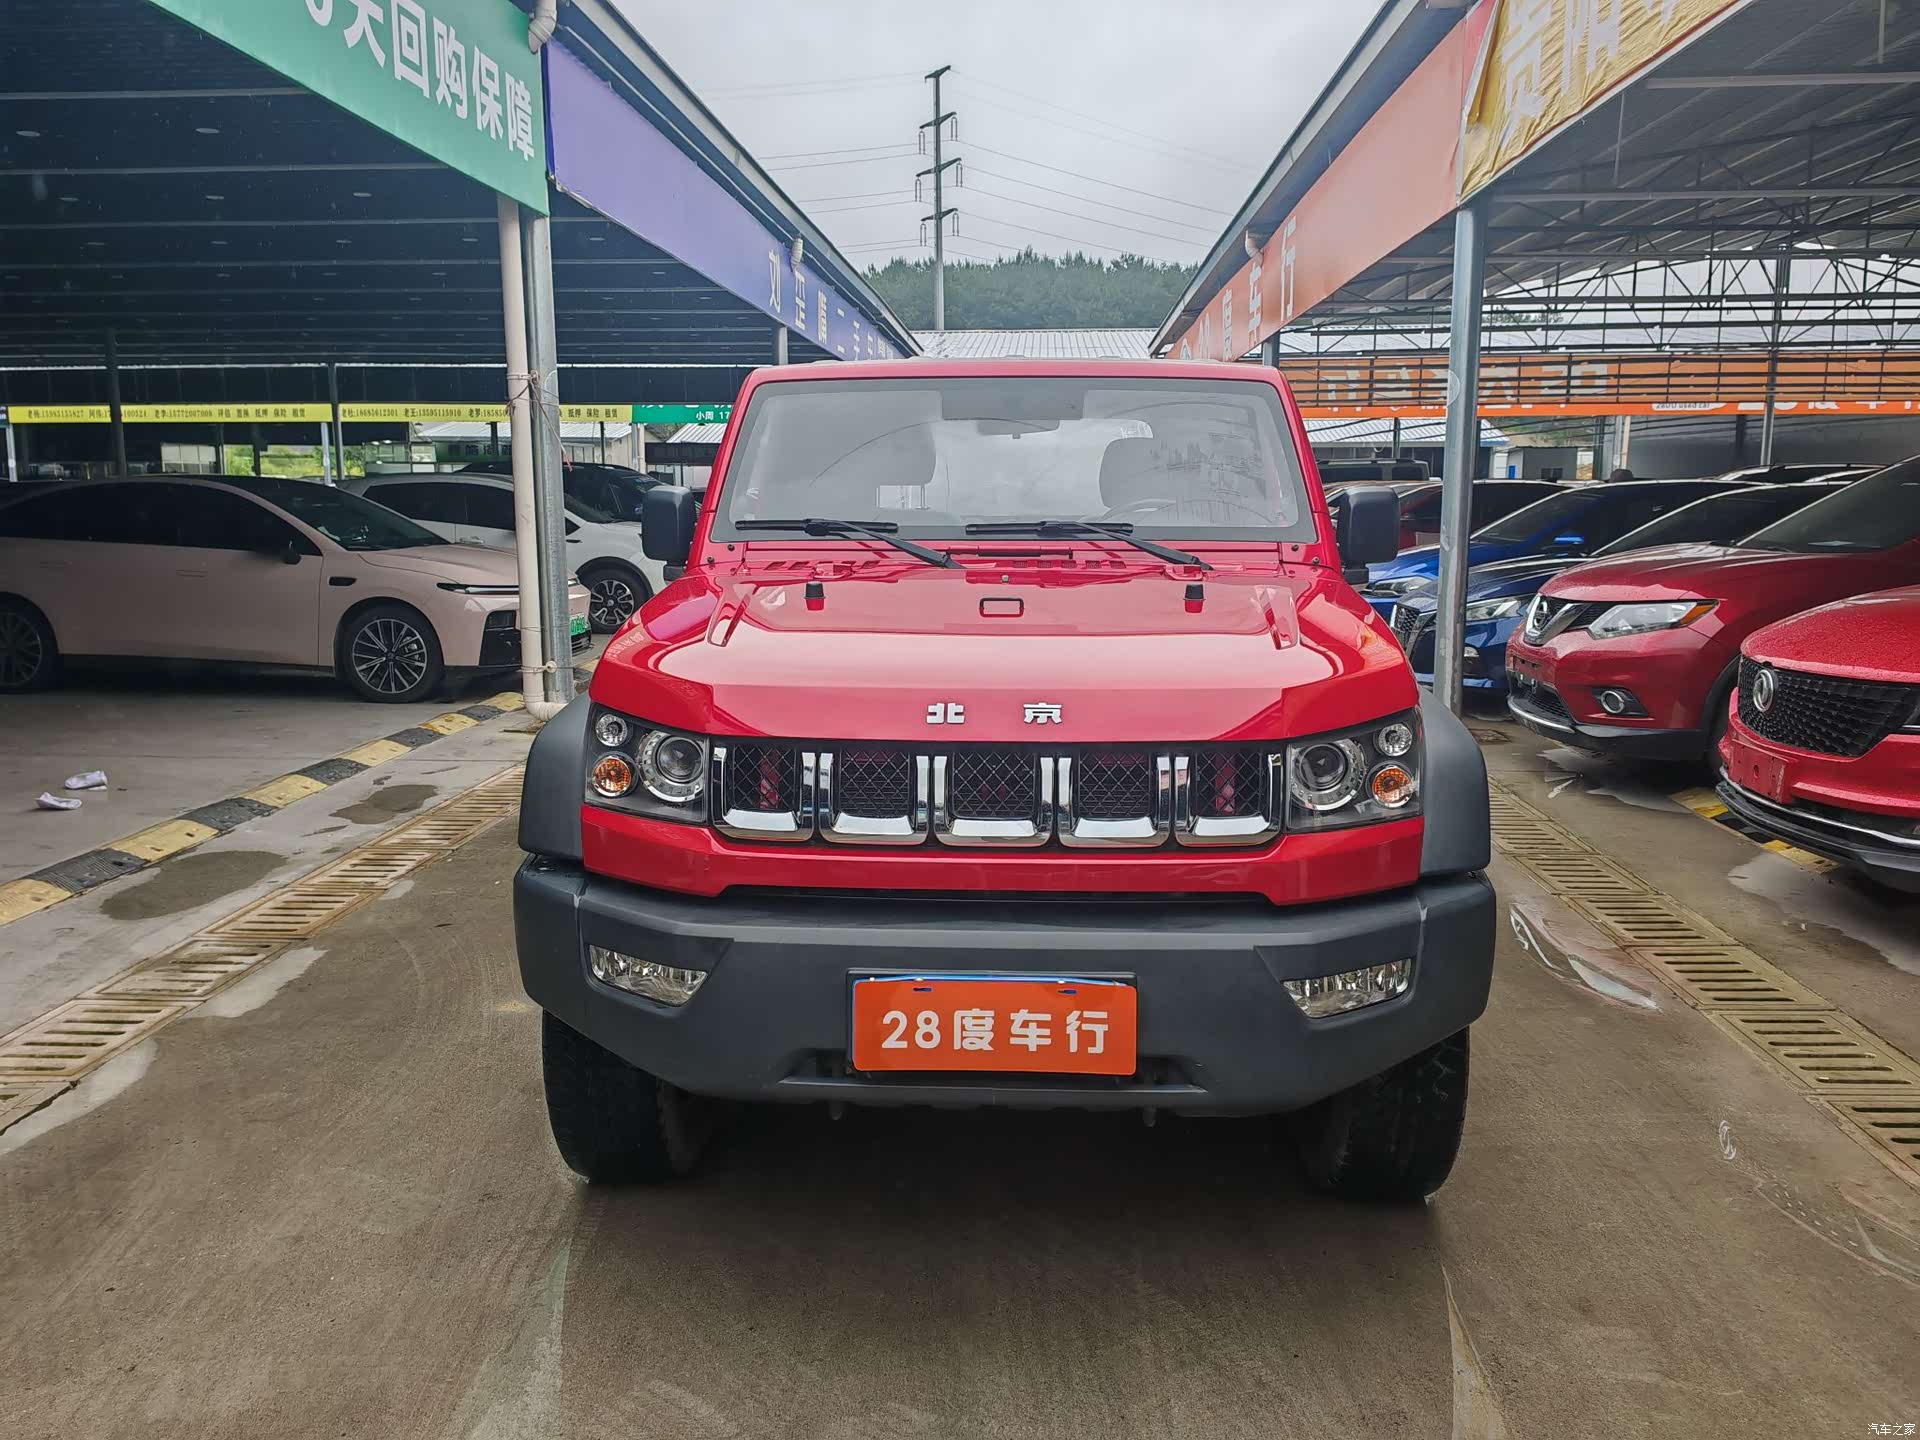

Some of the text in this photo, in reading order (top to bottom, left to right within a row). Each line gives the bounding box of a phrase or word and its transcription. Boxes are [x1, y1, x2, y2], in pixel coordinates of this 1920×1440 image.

[274, 408, 287, 418] 保险
[568, 408, 581, 418] 抵押
[586, 408, 600, 418] 保险
[695, 410, 714, 421] 小周
[881, 1008, 1109, 1054] 28度车行
